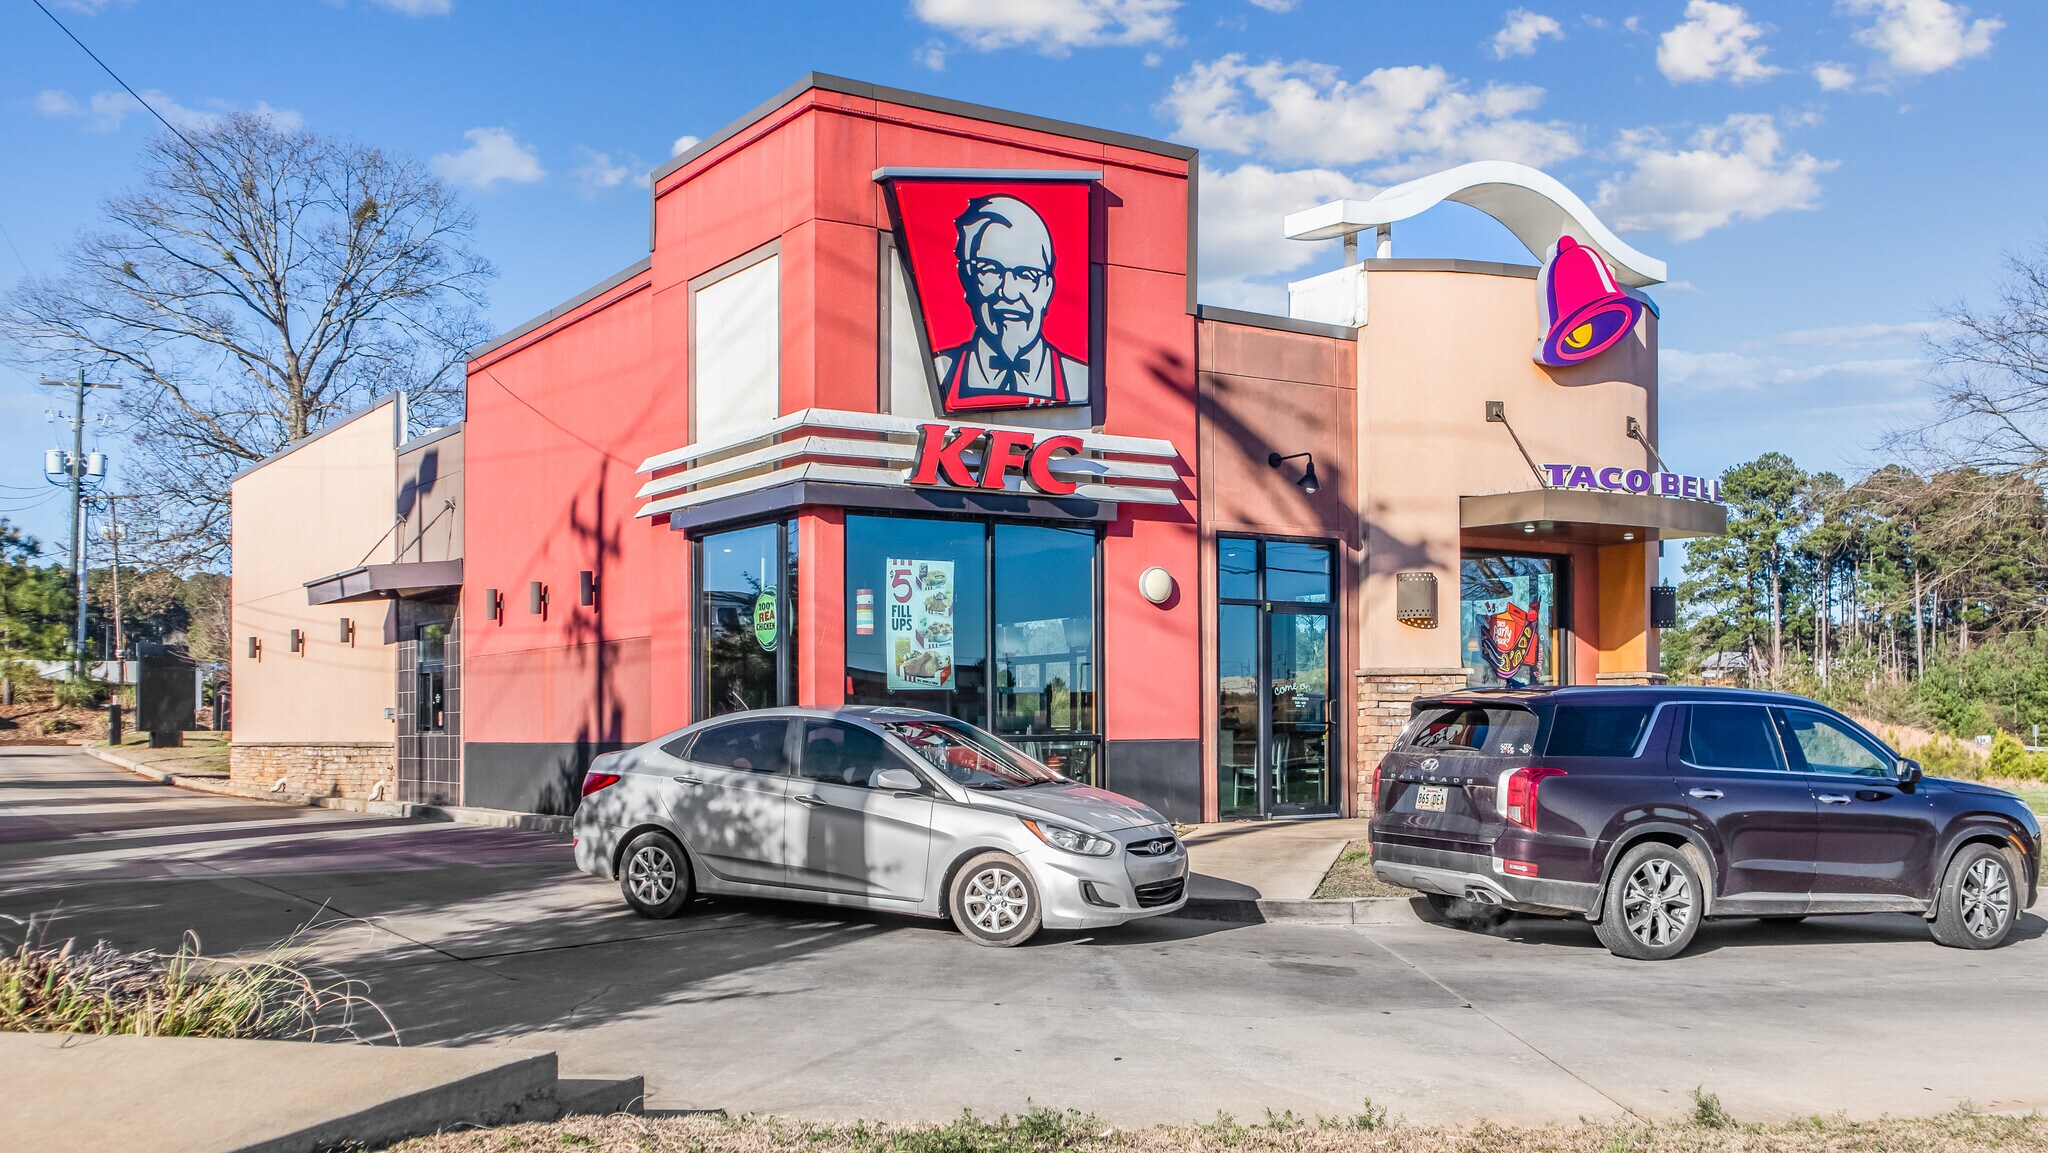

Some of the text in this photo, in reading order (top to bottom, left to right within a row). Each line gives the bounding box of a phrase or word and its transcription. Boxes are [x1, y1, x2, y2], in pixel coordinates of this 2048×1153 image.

[905, 424, 1084, 495] KFC
[1539, 464, 1725, 502] TACO BELL
[891, 605, 912, 617] FILL
[756, 622, 775, 631] CHICKEN
[891, 619, 912, 631] UPS
[1418, 793, 1430, 804] 865
